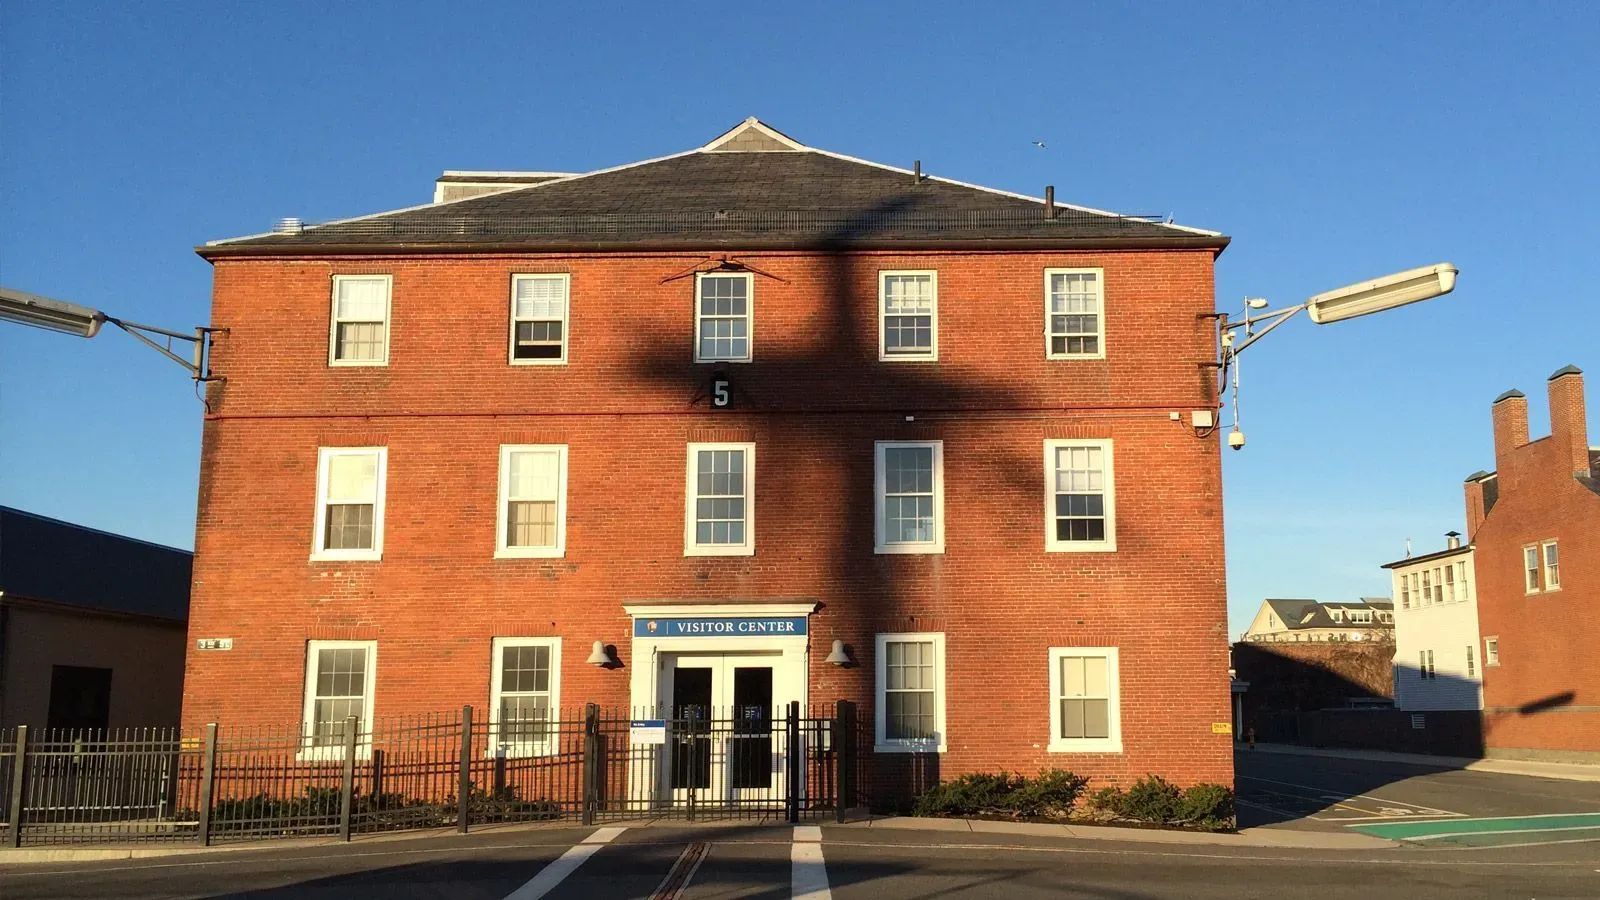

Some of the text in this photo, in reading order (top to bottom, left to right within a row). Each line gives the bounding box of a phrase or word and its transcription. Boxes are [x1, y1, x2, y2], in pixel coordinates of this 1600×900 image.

[714, 380, 729, 406] 5
[677, 621, 795, 633] VISITOR CENTER
